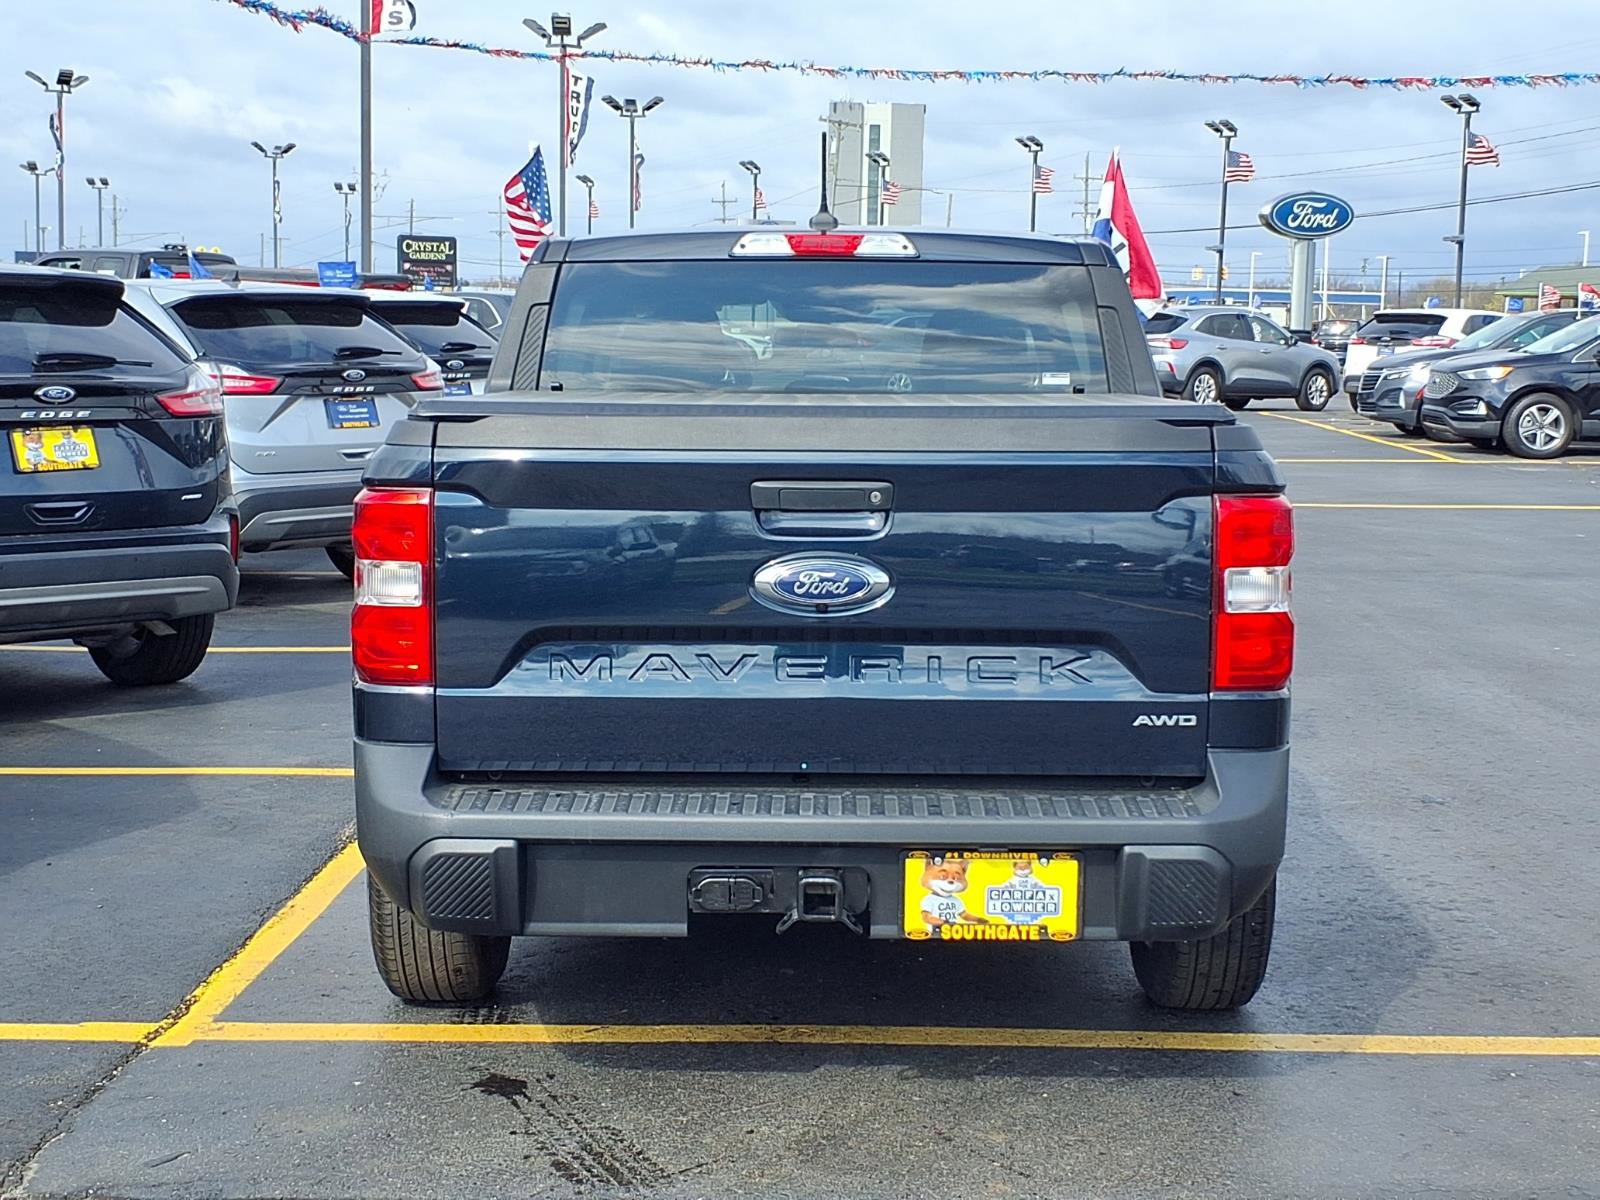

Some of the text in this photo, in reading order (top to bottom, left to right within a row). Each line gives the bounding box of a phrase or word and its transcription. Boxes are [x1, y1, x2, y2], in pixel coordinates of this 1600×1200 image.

[1287, 200, 1339, 228] Ford
[402, 239, 454, 255] CRYSTAL
[409, 252, 446, 260] GARDENS
[20, 410, 92, 419] EDGE
[793, 570, 850, 595] Ford
[549, 652, 1094, 685] MAVERICK
[1132, 714, 1197, 727] AWD
[989, 889, 1056, 901] CARFAX
[938, 902, 957, 911] CAR
[1001, 902, 1056, 912] OWNER
[939, 911, 957, 920] FOX
[941, 924, 1040, 940] SOUTHGATE
